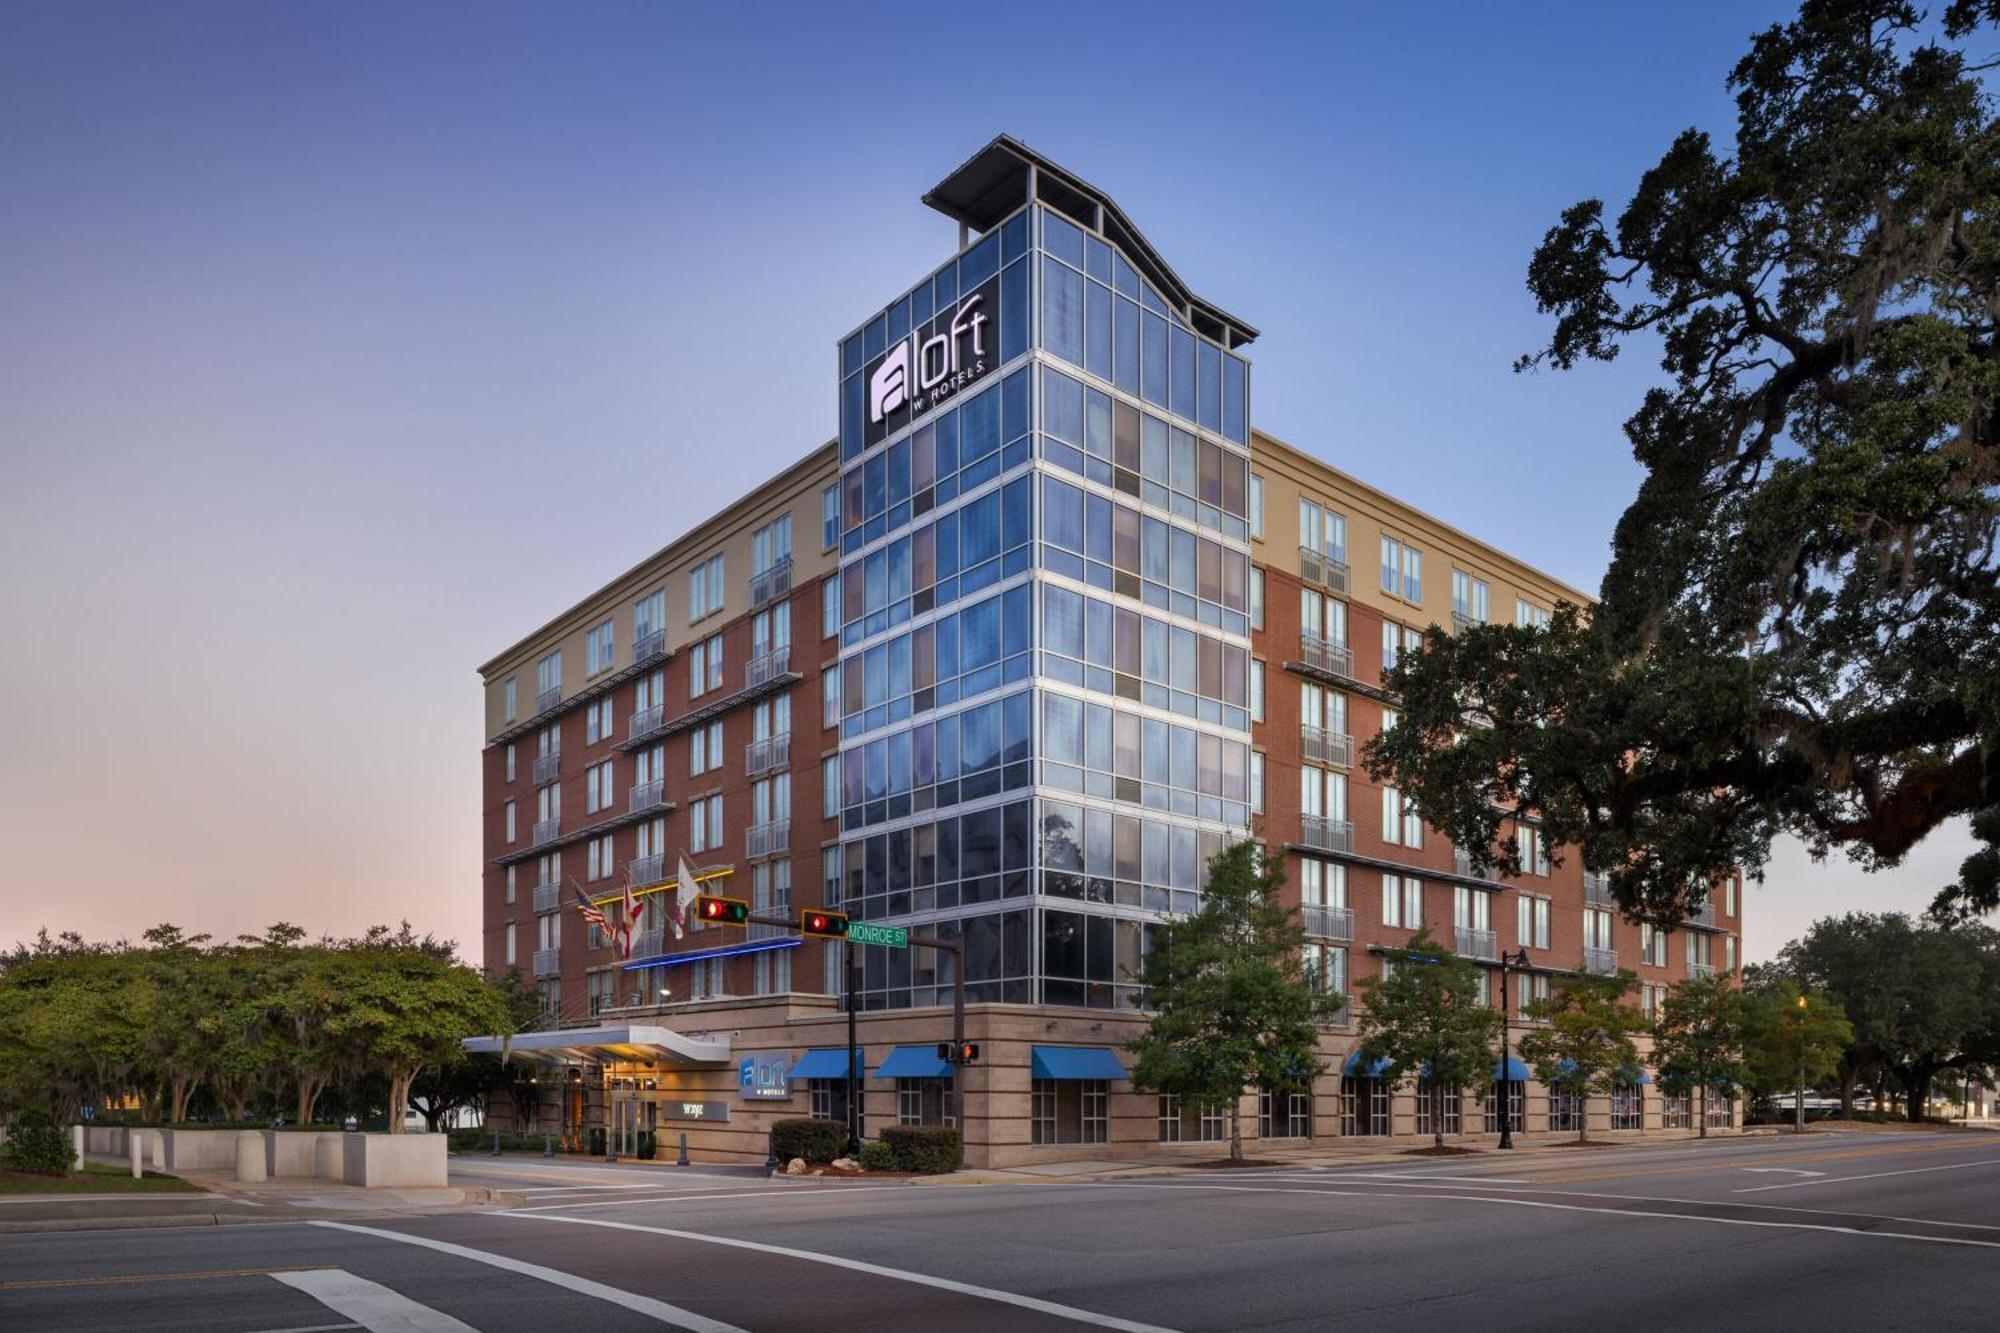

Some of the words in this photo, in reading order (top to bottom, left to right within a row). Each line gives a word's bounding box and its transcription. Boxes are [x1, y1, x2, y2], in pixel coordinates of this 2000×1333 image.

[913, 398, 924, 411] W
[931, 359, 985, 400] HOTELS
[848, 924, 893, 944] MONROE
[895, 931, 905, 943] ST
